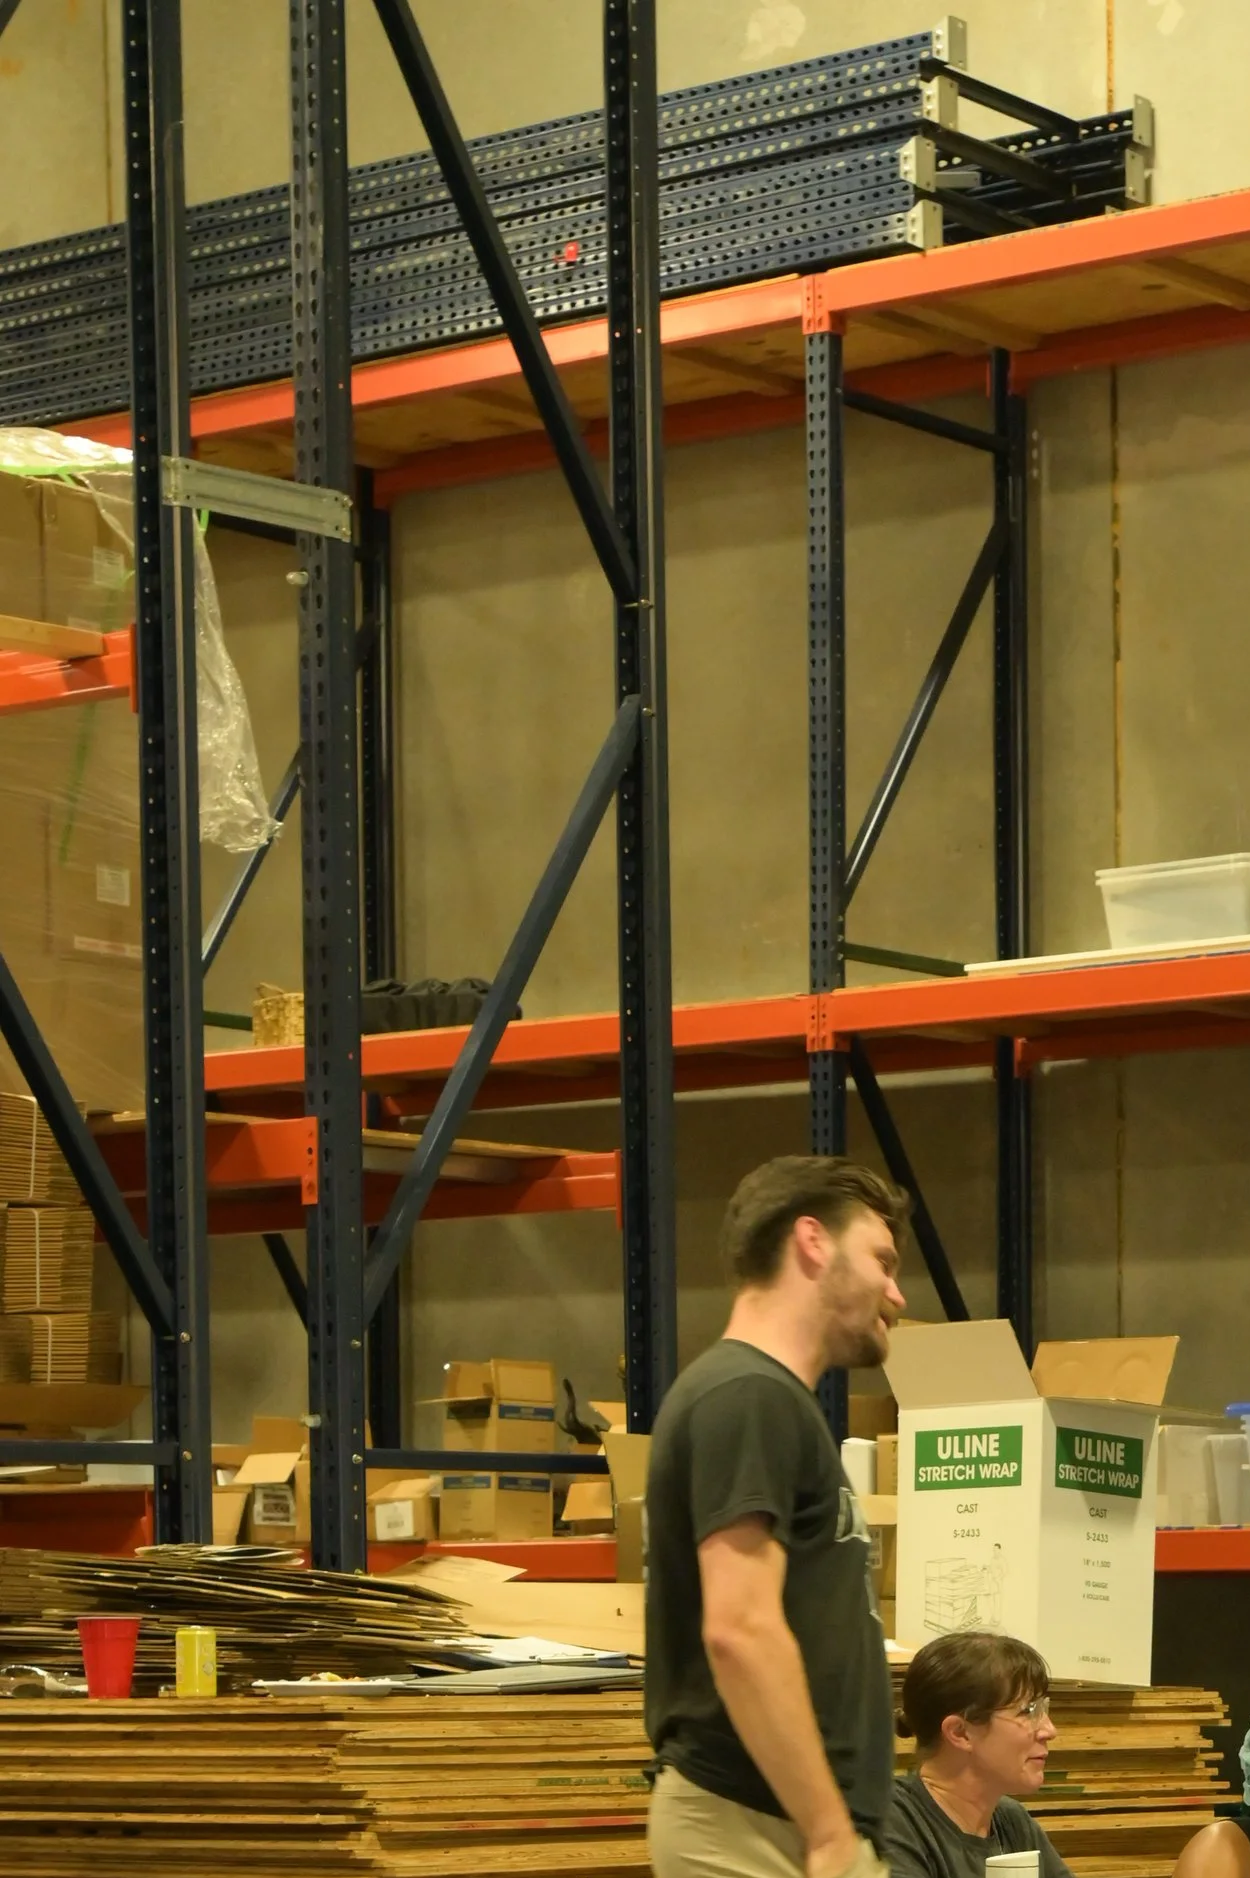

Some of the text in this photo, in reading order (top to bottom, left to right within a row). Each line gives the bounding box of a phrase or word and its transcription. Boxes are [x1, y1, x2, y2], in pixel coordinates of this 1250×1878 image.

[937, 1433, 1000, 1460] ULINE
[1074, 1436, 1125, 1466] ULINE
[919, 1462, 1018, 1482] STRETCH WRAP
[1058, 1464, 1139, 1489] STRETCH WRAP
[956, 1503, 978, 1514] CAST
[1089, 1507, 1108, 1518] CAST
[953, 1529, 980, 1538] S-2433
[1086, 1532, 1108, 1543] S-2433
